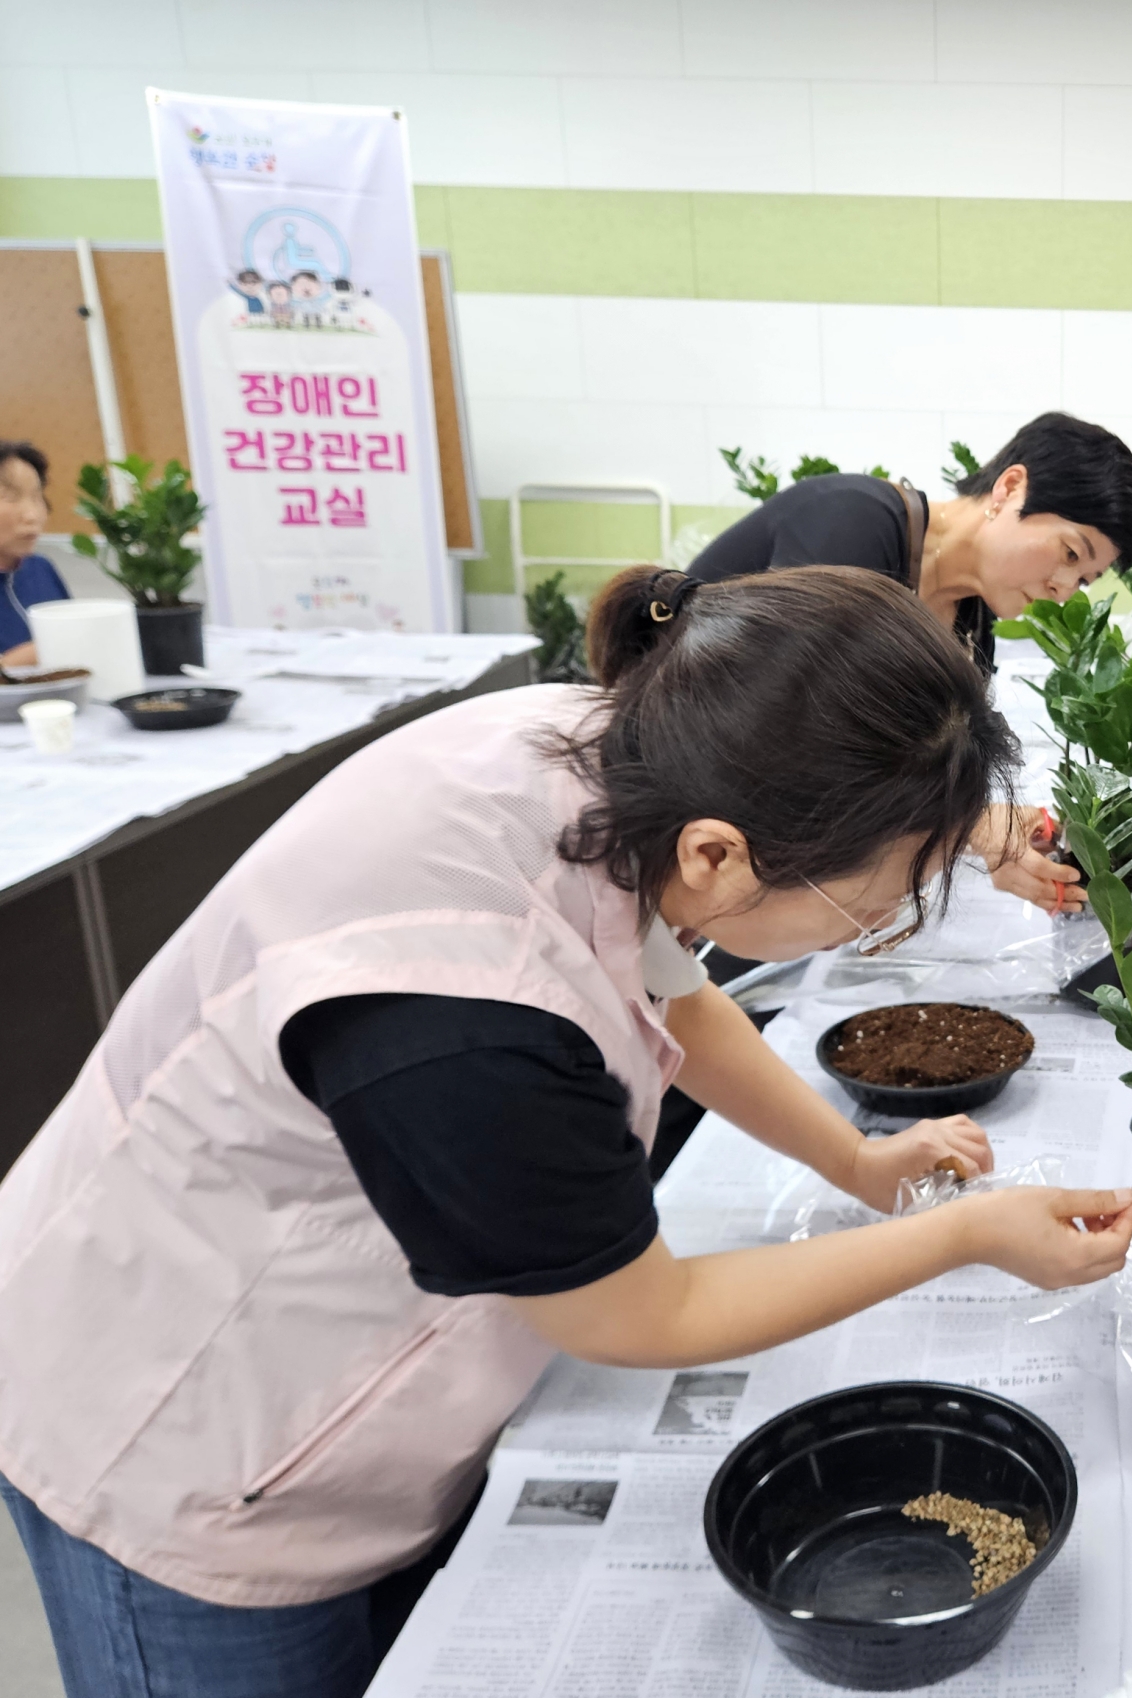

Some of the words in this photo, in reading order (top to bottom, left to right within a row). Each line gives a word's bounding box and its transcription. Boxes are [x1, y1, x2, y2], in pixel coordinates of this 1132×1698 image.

[239, 373, 379, 417] 장애인
[223, 430, 406, 473] 건강관리
[278, 487, 367, 527] 교실
